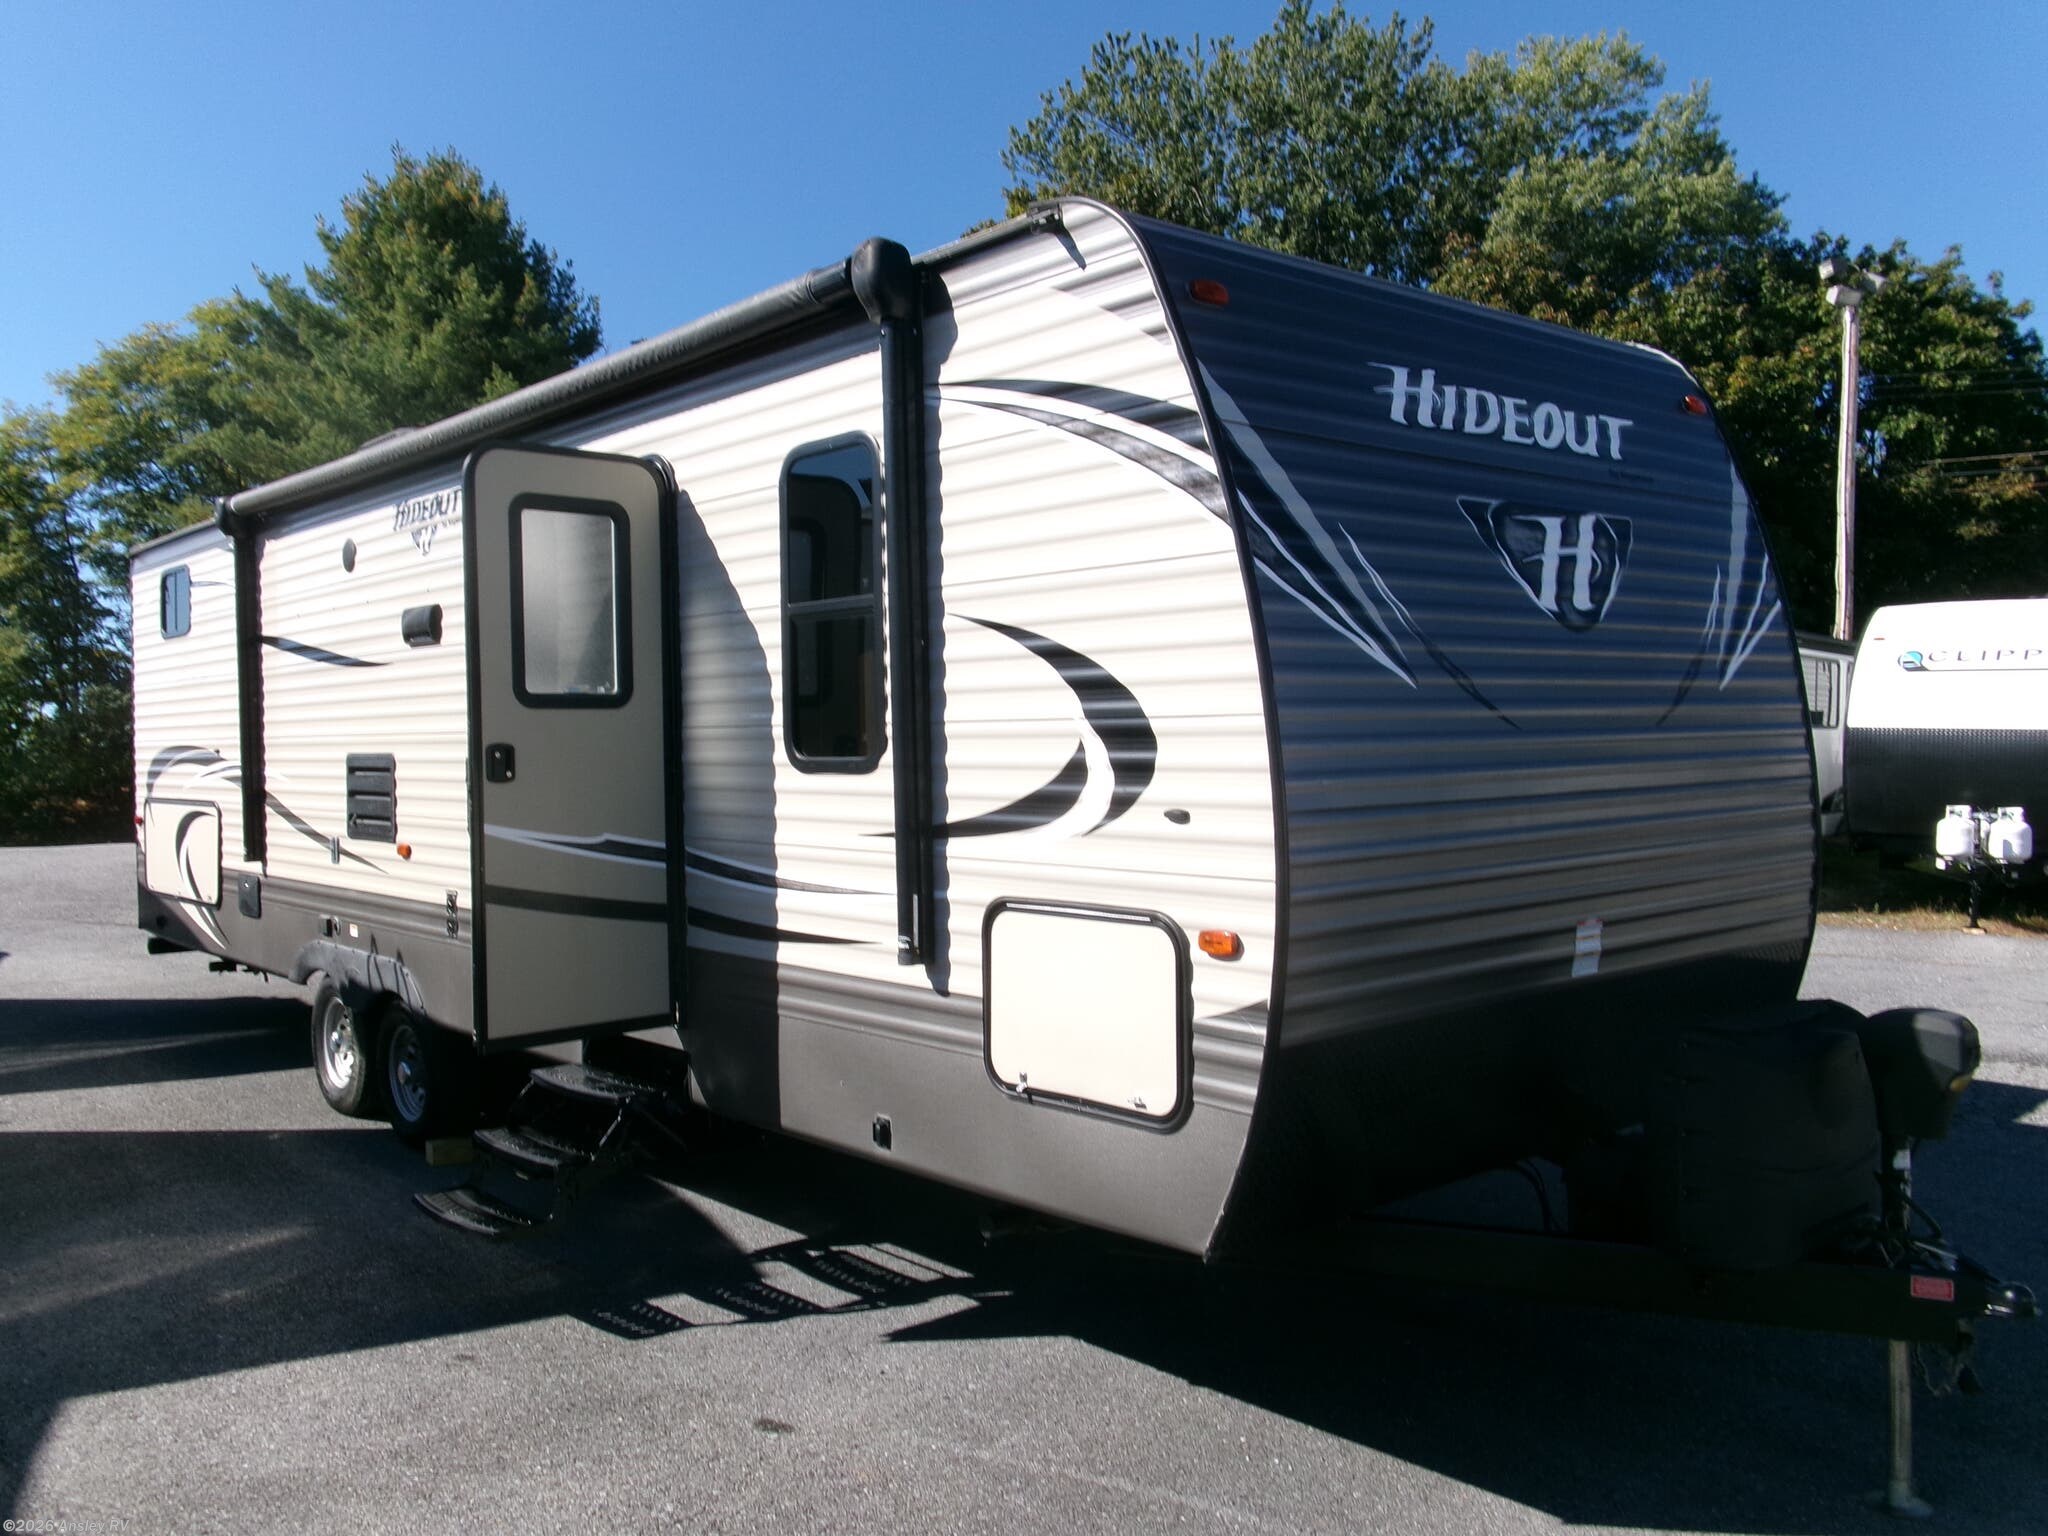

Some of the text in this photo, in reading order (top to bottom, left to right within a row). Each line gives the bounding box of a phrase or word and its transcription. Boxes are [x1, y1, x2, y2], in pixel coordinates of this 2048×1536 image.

[1367, 361, 1634, 461] HIDEOUT
[392, 488, 463, 532] HIDEOUT
[1511, 513, 1602, 613] H
